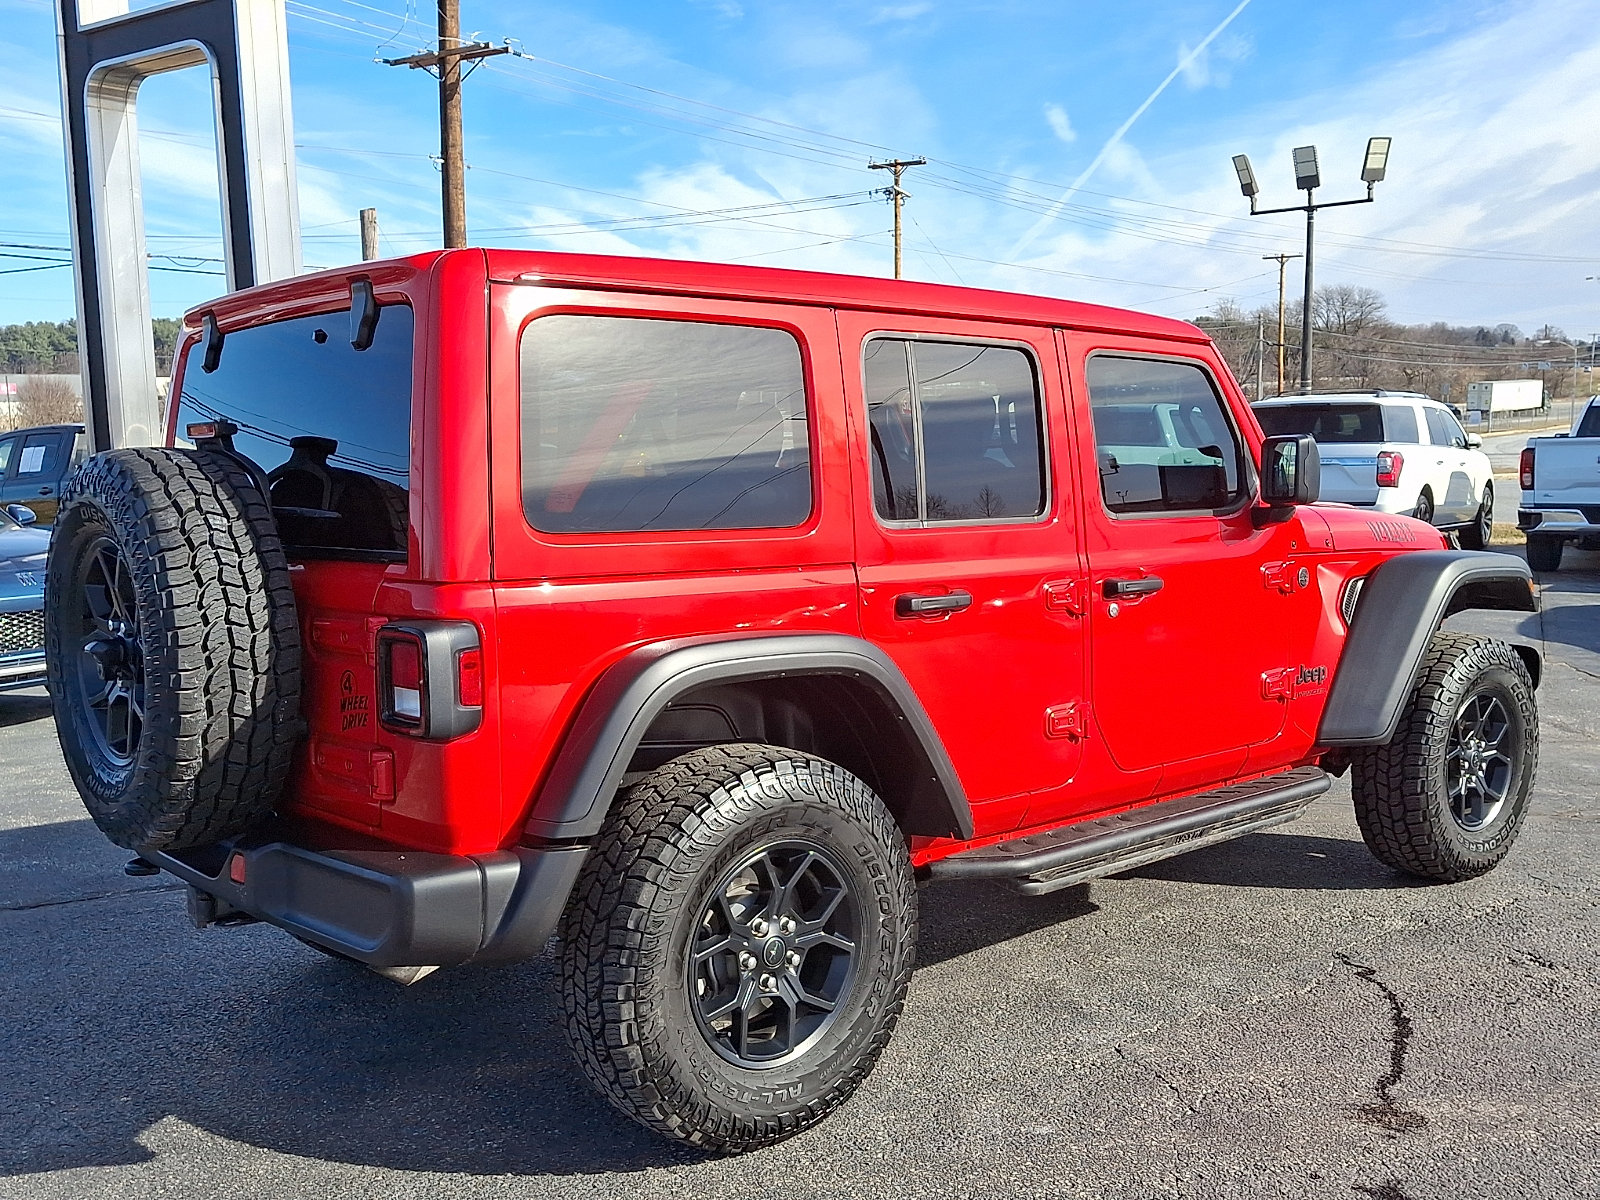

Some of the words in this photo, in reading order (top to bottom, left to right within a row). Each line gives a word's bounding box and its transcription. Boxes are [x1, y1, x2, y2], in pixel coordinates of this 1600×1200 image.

[342, 671, 354, 695] 4
[1295, 664, 1327, 686] Jeep
[340, 695, 368, 712] WHEEL
[341, 713, 368, 732] DRIVE
[1457, 814, 1516, 853] DISCOVERER
[852, 841, 897, 1019] DISCOVERER
